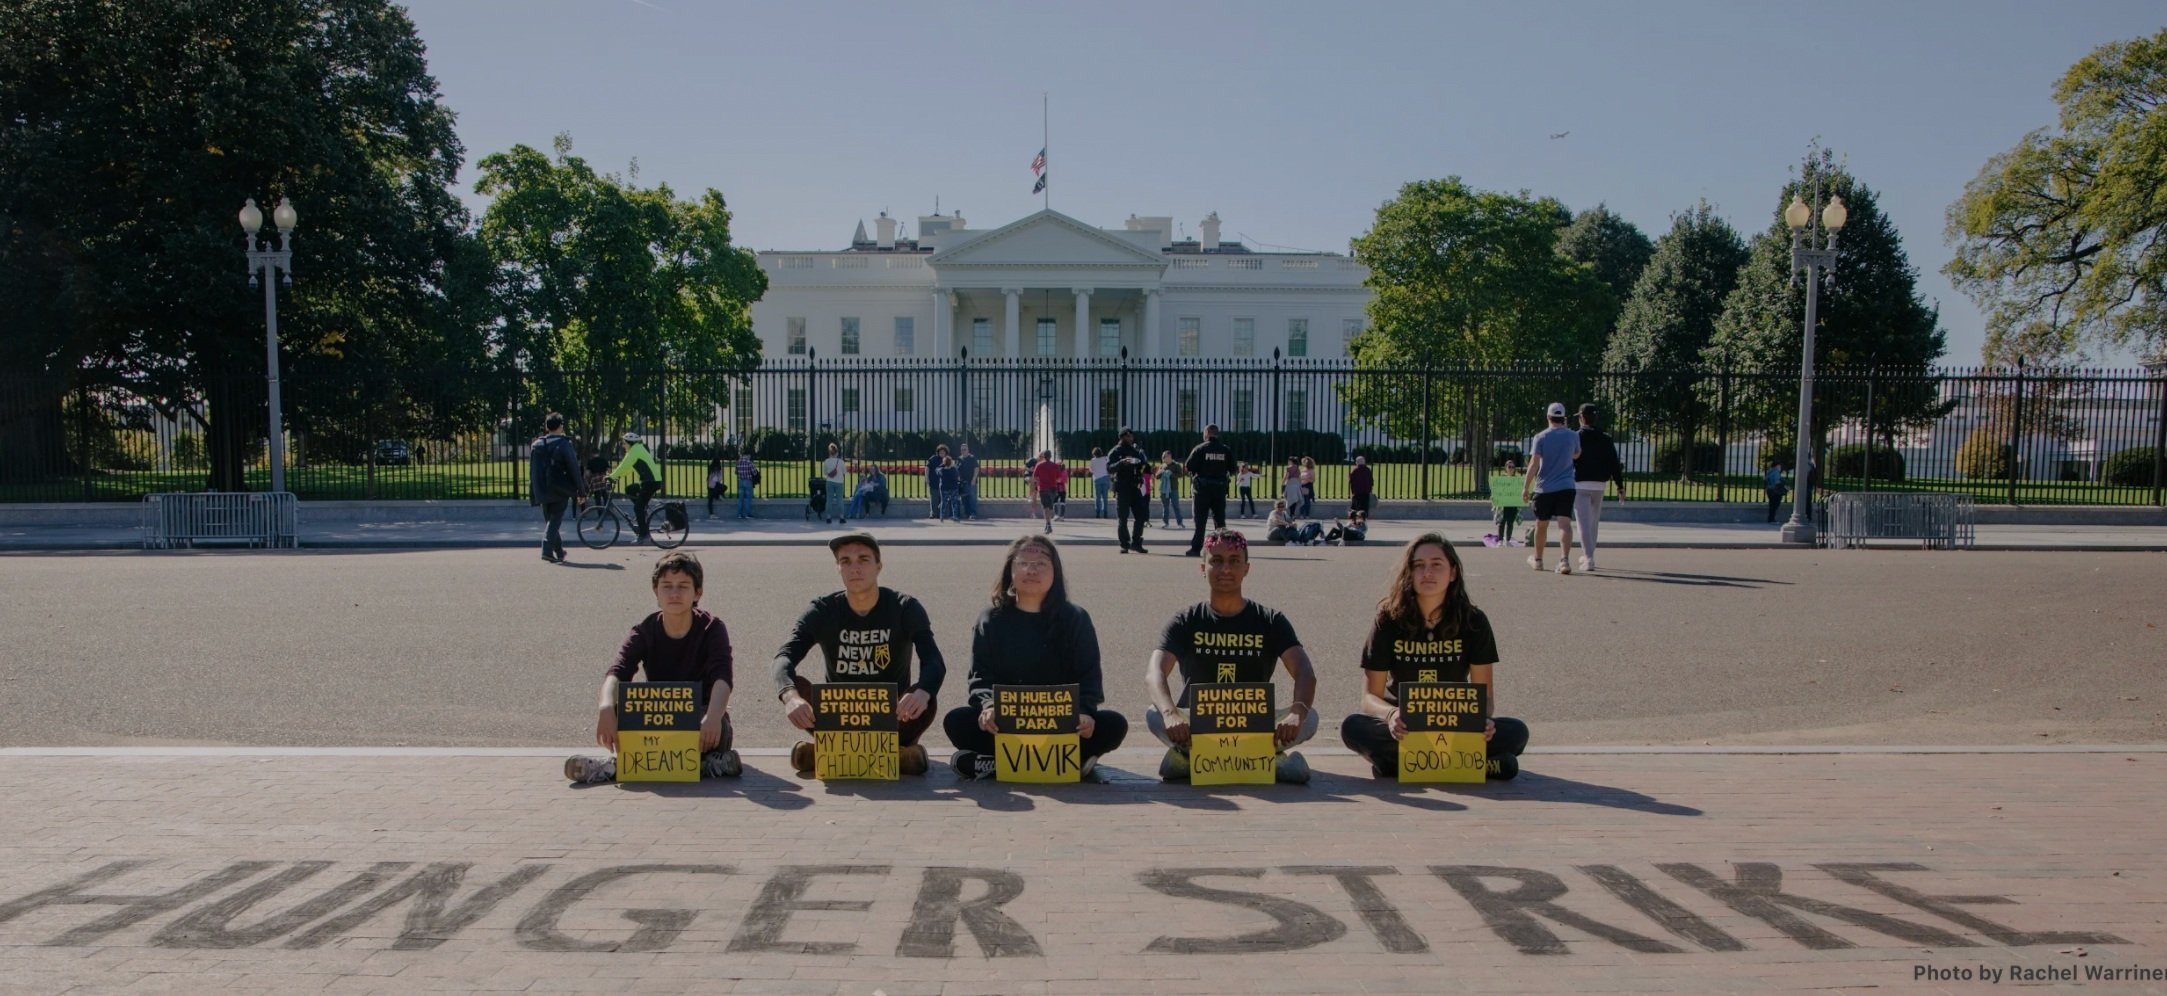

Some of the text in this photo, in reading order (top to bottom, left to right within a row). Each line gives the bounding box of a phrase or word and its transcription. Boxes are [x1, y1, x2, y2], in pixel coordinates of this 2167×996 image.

[1205, 453, 1225, 461] POLICE
[840, 629, 891, 645] GREEN
[1194, 631, 1264, 649] SUNRISE
[838, 645, 873, 660] NEW
[1195, 648, 1261, 657] MOVEMENT
[1393, 639, 1463, 655] SUNRISE
[1395, 655, 1461, 663] MOVEMENT
[836, 660, 879, 675] DEAL
[626, 687, 693, 699] HUNGER
[820, 689, 888, 701] HUNGER
[1000, 691, 1072, 703] EN HUELGA
[1198, 688, 1266, 702] HUNGER
[1408, 687, 1478, 700] HUNGER
[624, 701, 694, 712] STRIKING
[820, 701, 890, 714] STRIKING
[1001, 704, 1073, 717] DE HAMBRE
[1196, 702, 1268, 716] STRIKING
[1407, 701, 1479, 714] STRIKING
[643, 714, 674, 726] FOR
[840, 714, 871, 726] FOR
[1016, 718, 1058, 730] PARA
[1216, 716, 1247, 728] FOR
[1426, 714, 1458, 726] FOR
[643, 736, 660, 746] MY
[815, 732, 897, 754] MY FUTURE
[1219, 735, 1239, 748] MY
[1435, 733, 1448, 746] A
[623, 748, 697, 775] DREAMS
[816, 753, 897, 778] CHILDREN
[1002, 742, 1079, 776] VIVIR
[1193, 753, 1275, 774] COMMUNITY
[1404, 750, 1485, 773] GOOD JOB
[0, 860, 2140, 958] HUNGER STRIKE
